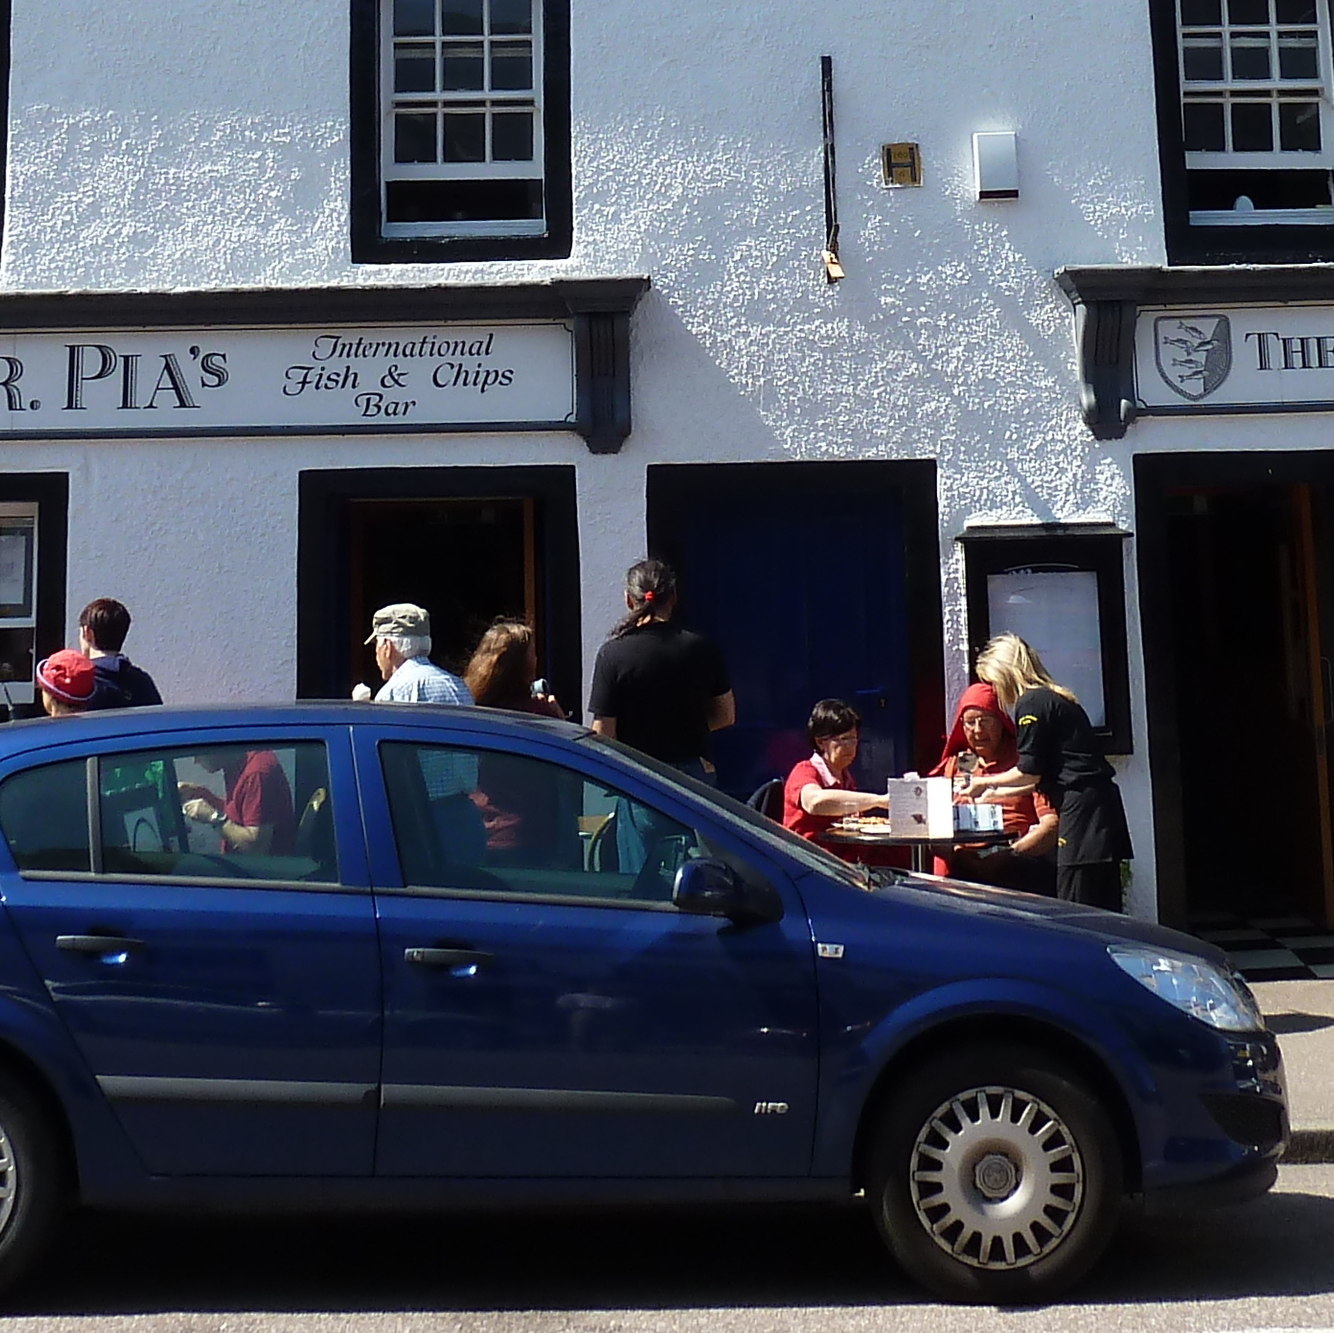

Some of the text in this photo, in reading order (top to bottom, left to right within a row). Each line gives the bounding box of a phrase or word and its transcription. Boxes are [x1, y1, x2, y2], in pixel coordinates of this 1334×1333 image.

[312, 333, 495, 361] International
[283, 362, 515, 397] Fish & Chips
[354, 392, 417, 417] Bar
